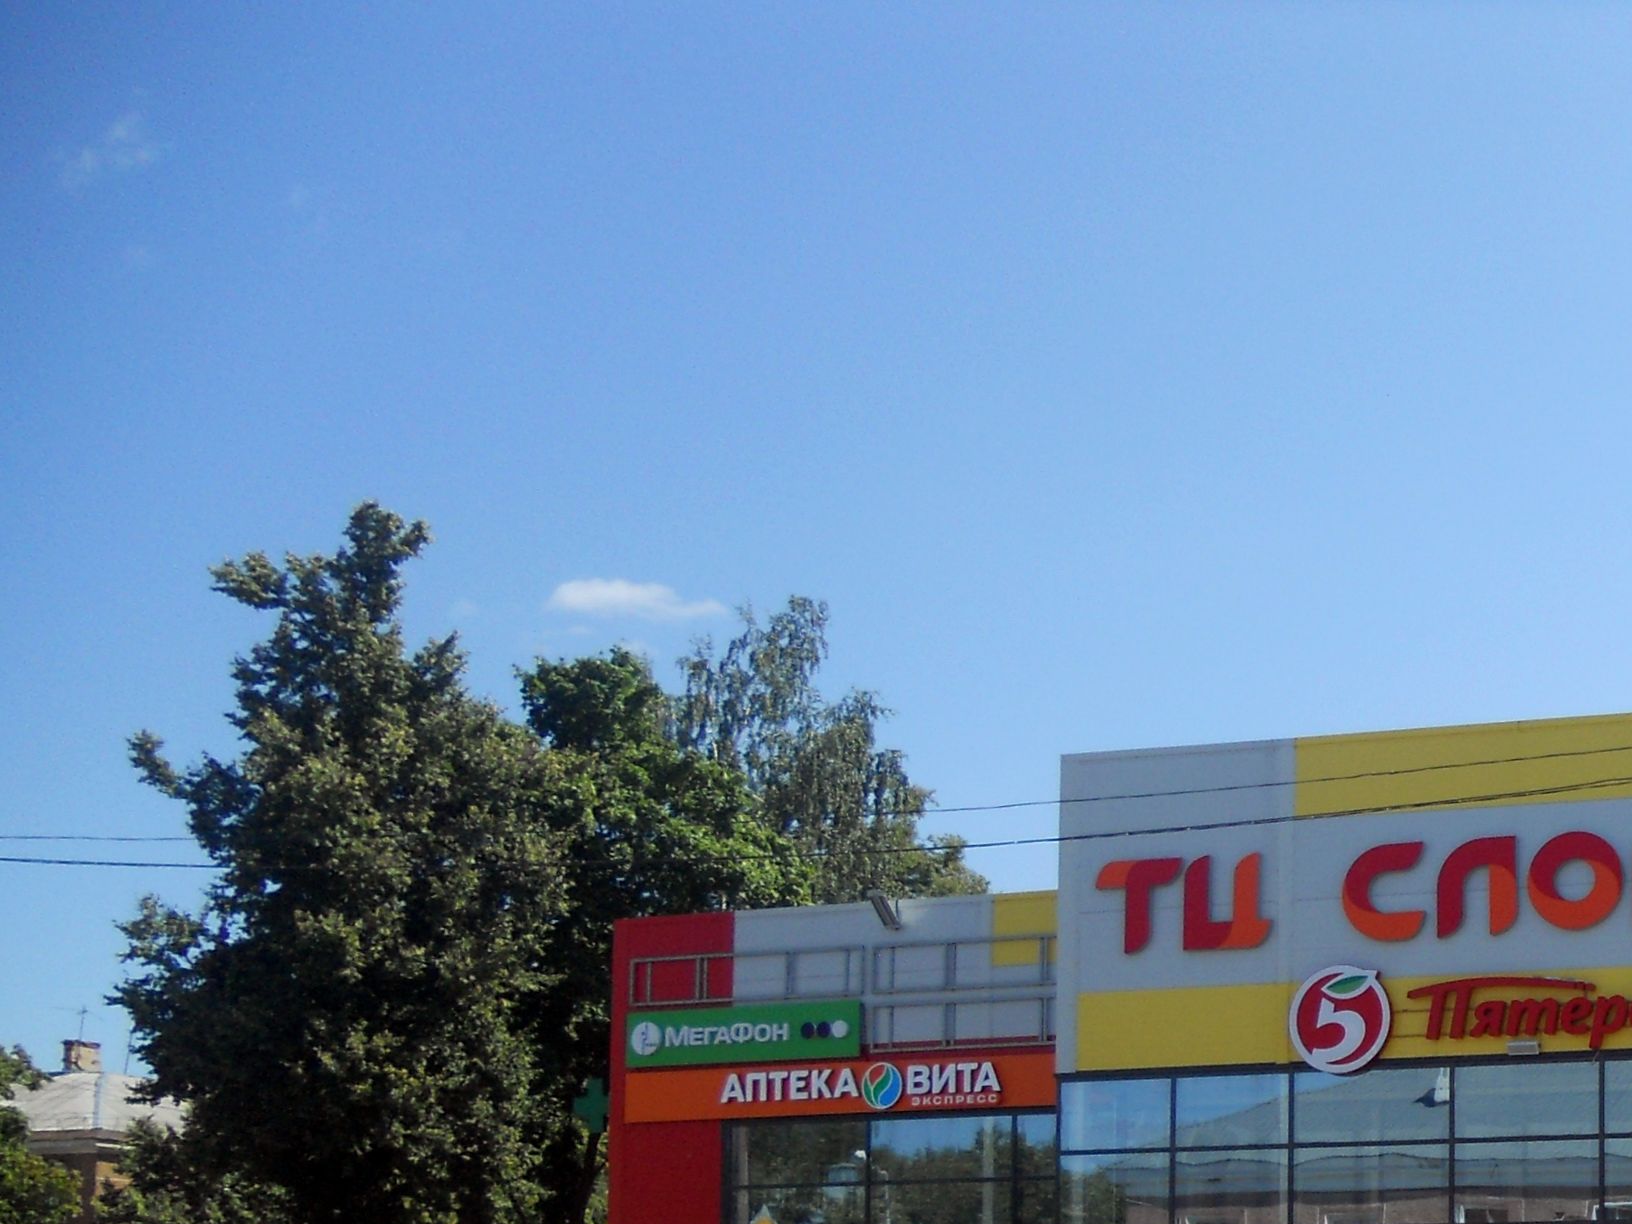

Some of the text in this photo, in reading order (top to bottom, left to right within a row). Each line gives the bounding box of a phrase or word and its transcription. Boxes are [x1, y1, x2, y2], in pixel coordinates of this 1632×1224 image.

[1095, 851, 1273, 955] ТЦ
[720, 1061, 1002, 1104] АПТЕКА ВИТА
[911, 1093, 998, 1107] ЭКСПРЕСС
